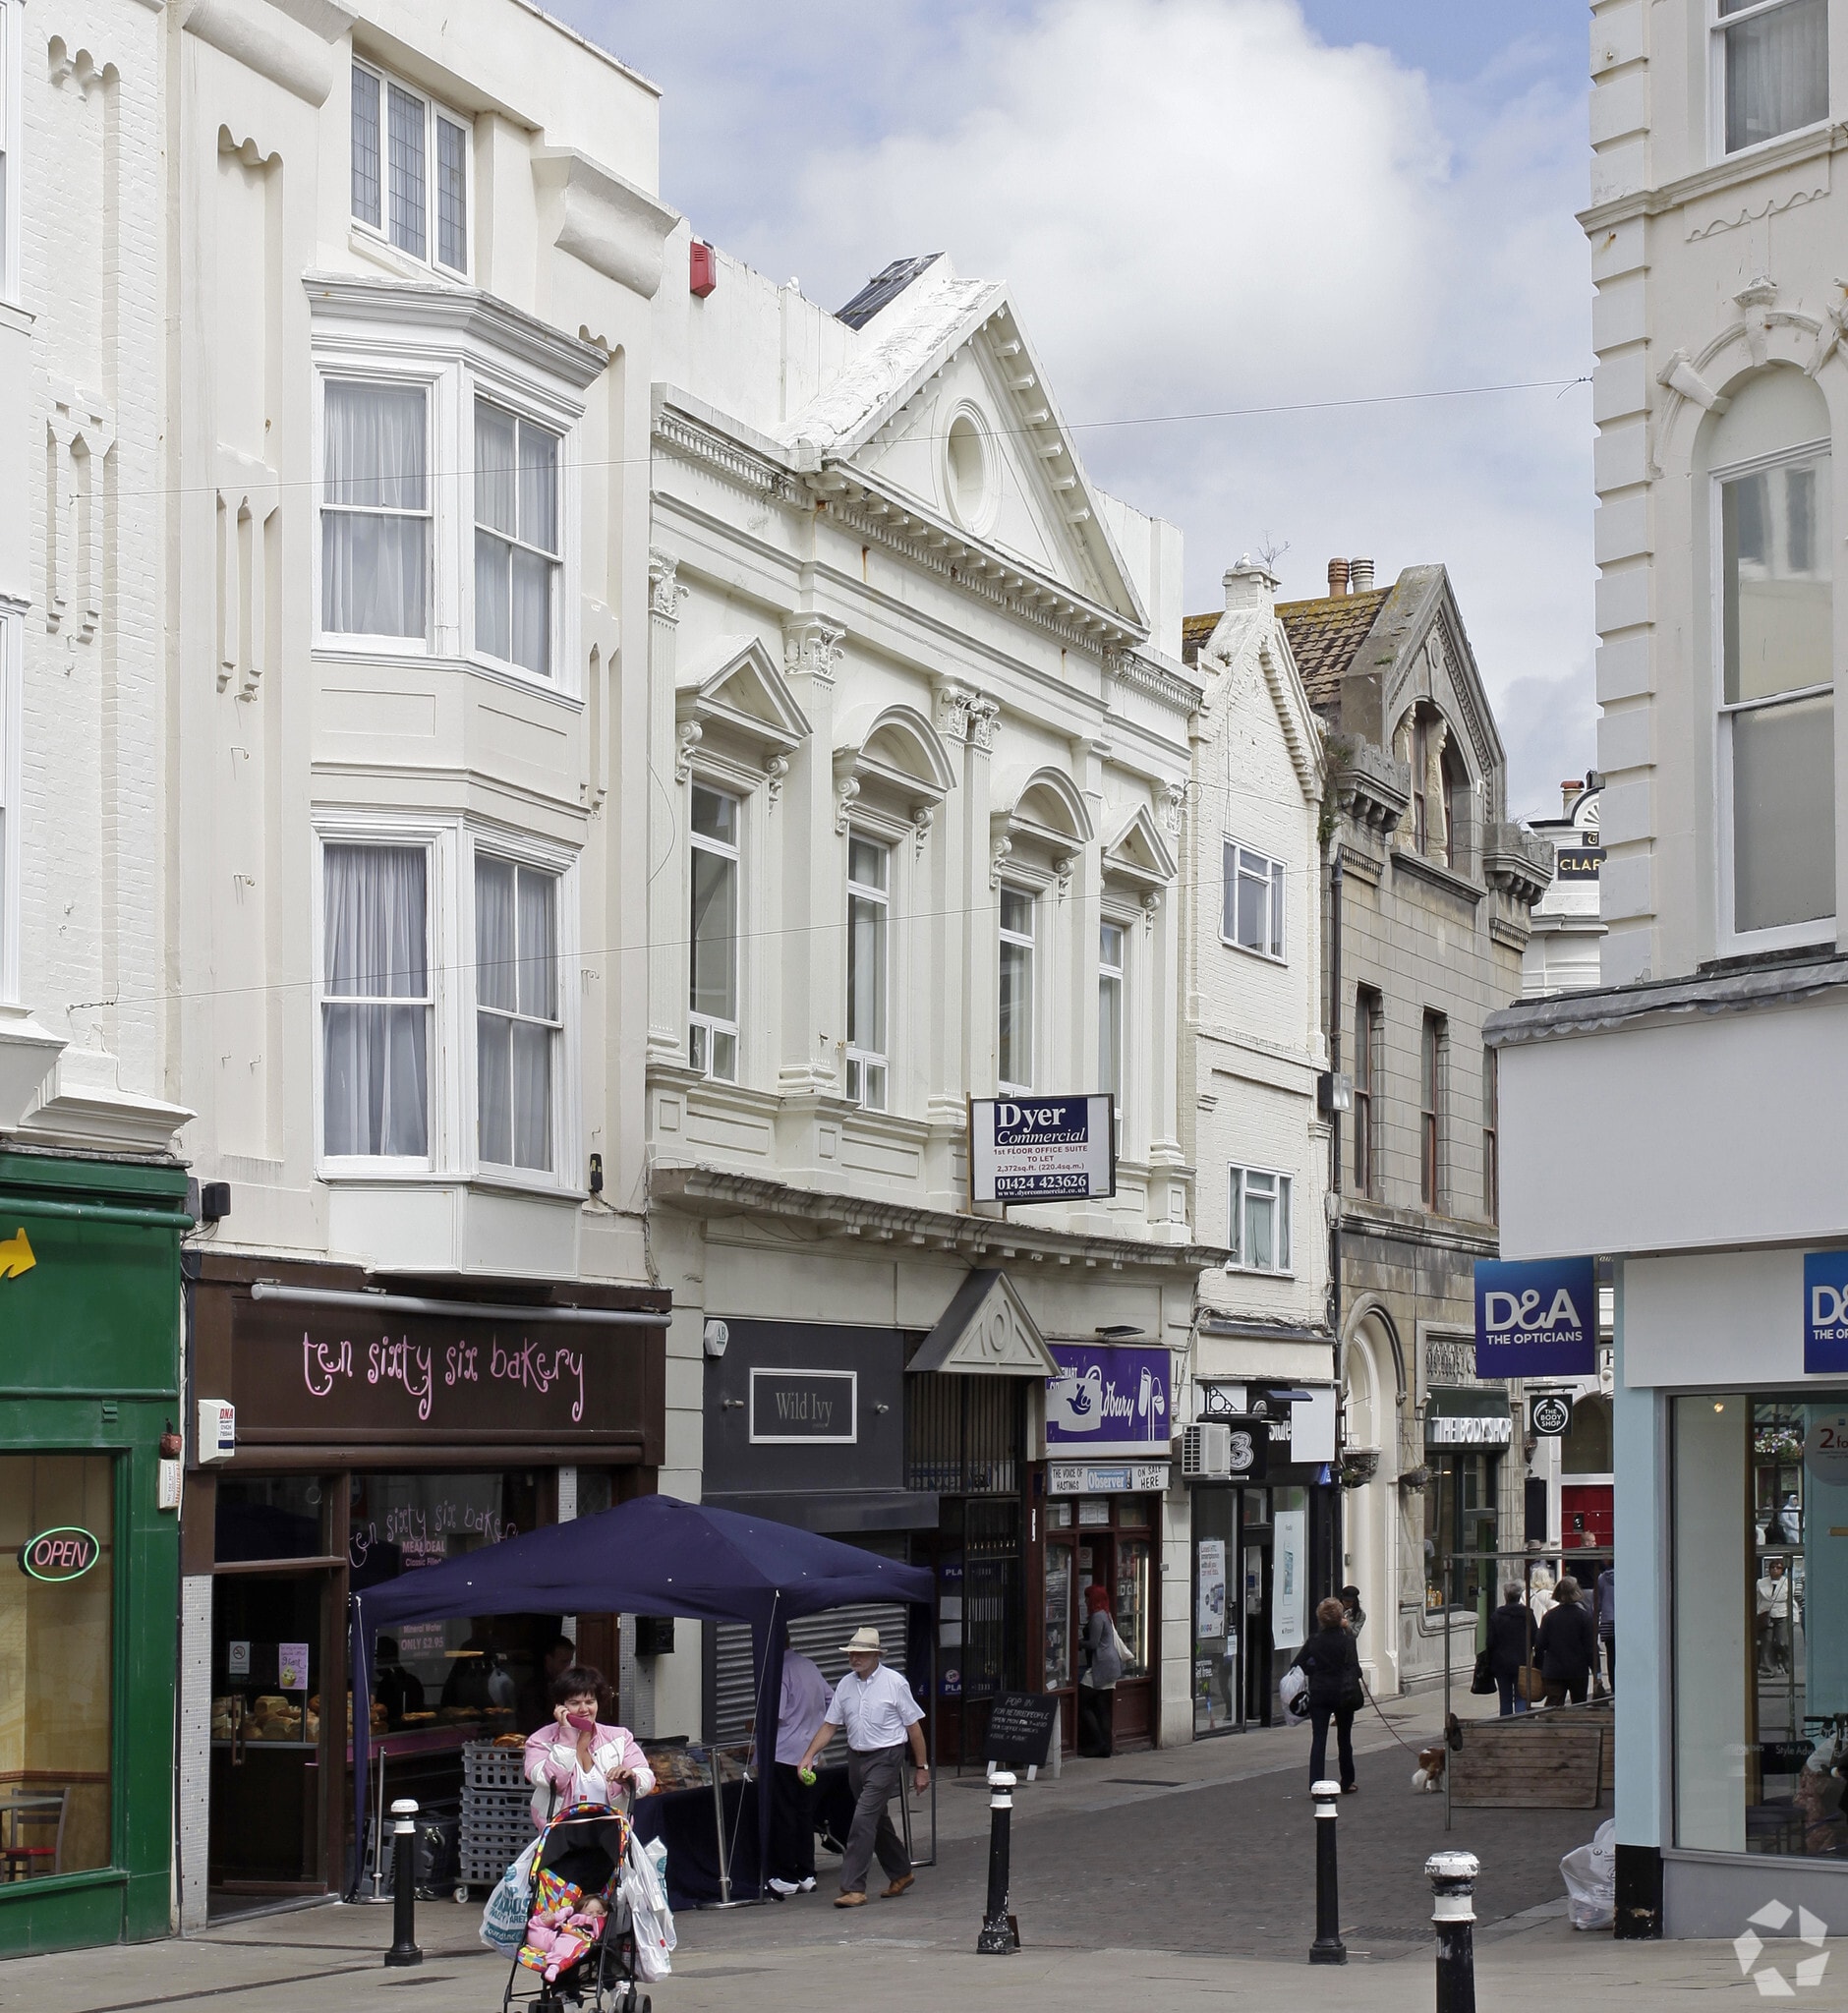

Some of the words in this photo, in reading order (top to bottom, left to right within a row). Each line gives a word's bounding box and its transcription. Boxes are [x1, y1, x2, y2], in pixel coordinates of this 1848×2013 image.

[997, 1103, 1067, 1133] Dyer
[997, 1127, 1085, 1144] Commercial
[997, 1178, 1034, 1190] 01424
[1039, 1175, 1086, 1188] 423626
[998, 1187, 1086, 1196] www.dyercommercial.co.uk
[1485, 1289, 1582, 1331] D&A
[1486, 1335, 1511, 1345] THE
[1514, 1331, 1583, 1344] OPTICIANS
[1813, 1329, 1833, 1340] THE
[303, 1332, 353, 1396] ten
[368, 1335, 433, 1420] sixty
[445, 1340, 478, 1386] six
[491, 1333, 585, 1422] bakery
[219, 1409, 234, 1419] DNA
[775, 1392, 808, 1419] Wild
[811, 1393, 833, 1427] Ivy
[1431, 1416, 1458, 1443] THE
[1460, 1417, 1486, 1443] BODY
[1486, 1417, 1513, 1443] SHOP
[1819, 1428, 1834, 1448] 2
[1053, 1468, 1062, 1478] THE
[1063, 1467, 1076, 1478] VOICE
[1076, 1467, 1083, 1476] OF
[1138, 1468, 1146, 1477] ON
[1148, 1466, 1162, 1475] SALE
[1057, 1480, 1079, 1491] HASTINGS
[1088, 1471, 1125, 1490] Observer
[1141, 1475, 1159, 1488] HERE
[435, 1500, 456, 1531] six
[465, 1502, 519, 1544] baker
[426, 1540, 445, 1552] DEAL
[34, 1539, 88, 1568] OPEN
[401, 1639, 422, 1650] ONLY
[423, 1637, 443, 1649] £2.95
[1006, 1697, 1022, 1706] POP
[1776, 1745, 1794, 1756] Style
